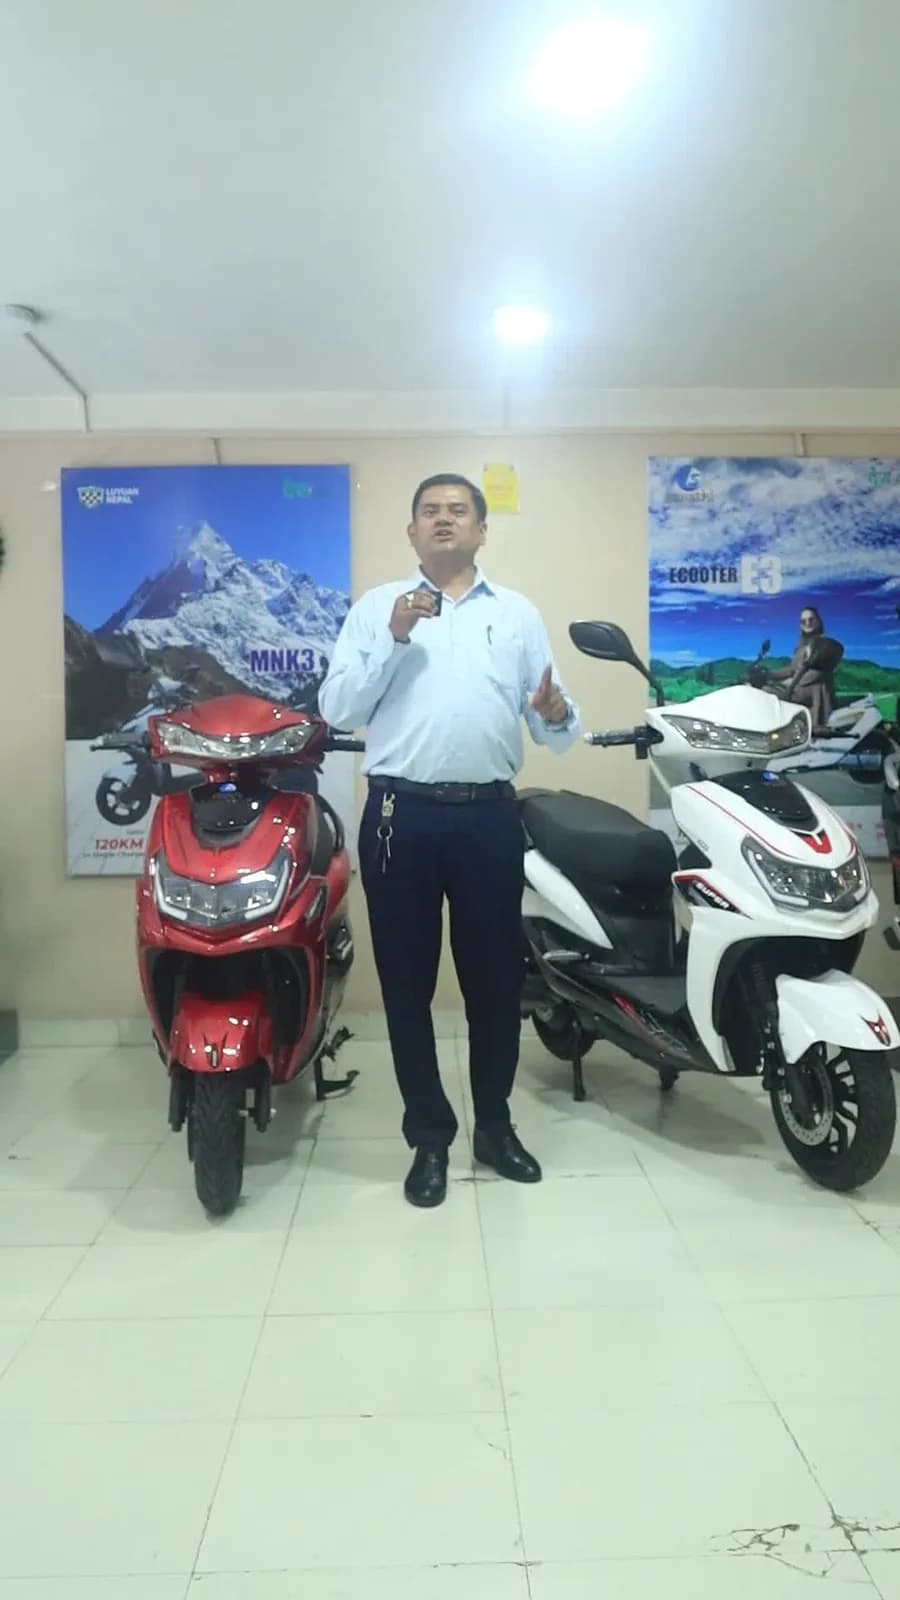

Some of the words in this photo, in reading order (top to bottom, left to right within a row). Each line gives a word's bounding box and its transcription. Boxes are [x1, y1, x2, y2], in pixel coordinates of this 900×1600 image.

[106, 496, 133, 504] NEPAL
[669, 567, 738, 584] ECOOTER
[741, 555, 782, 595] E3
[251, 649, 314, 672] MNK3
[95, 839, 144, 850] 120KM
[695, 881, 730, 909] SUPER
